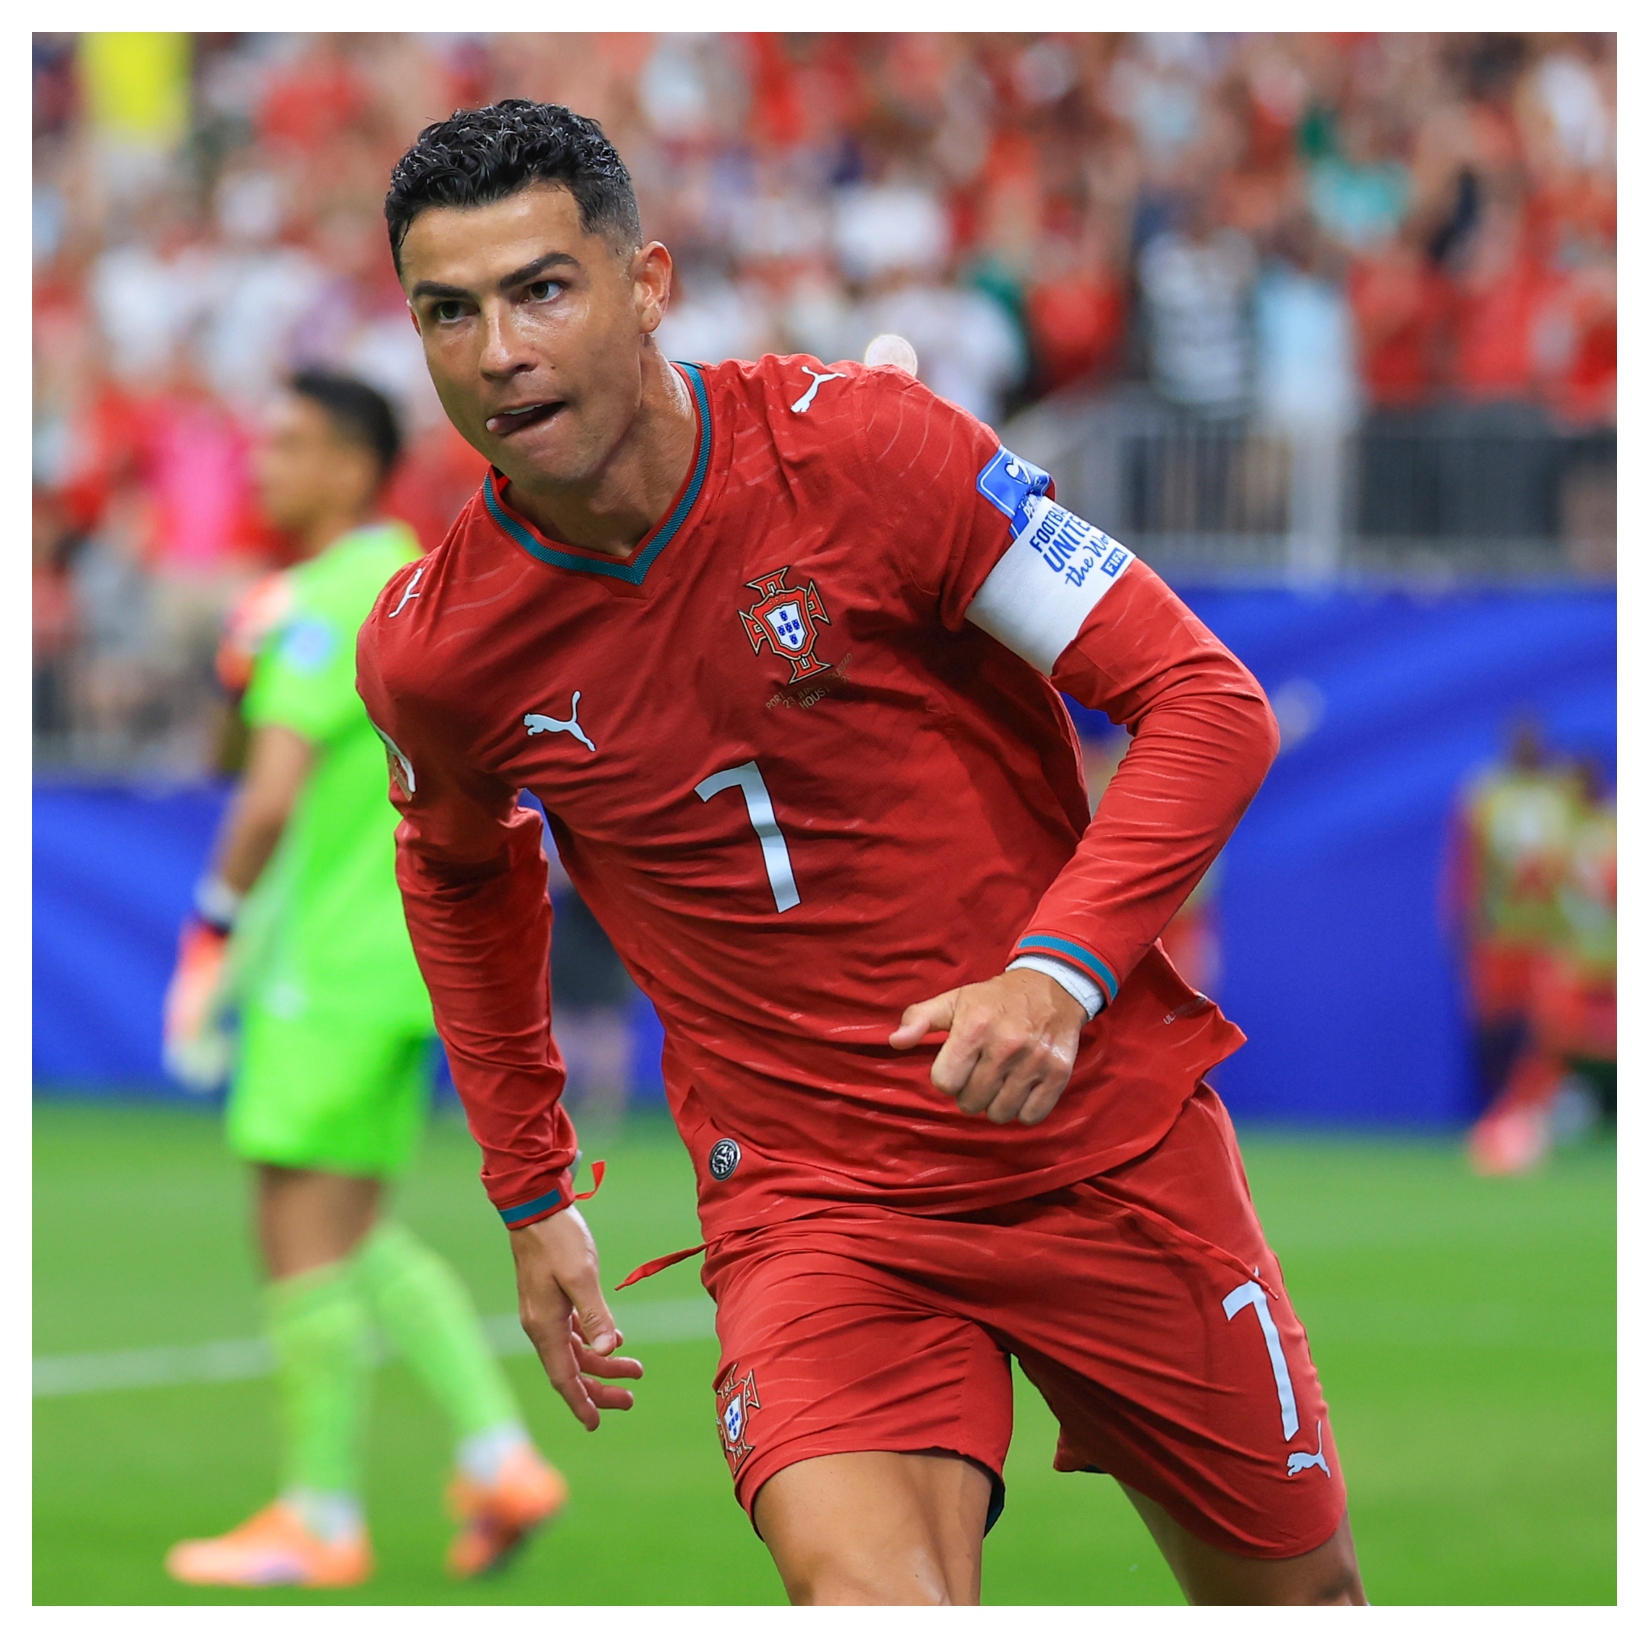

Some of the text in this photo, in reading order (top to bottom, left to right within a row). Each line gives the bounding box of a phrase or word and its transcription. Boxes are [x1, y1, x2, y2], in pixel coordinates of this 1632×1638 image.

[1029, 506, 1069, 553] FOOTBA
[1043, 515, 1091, 573] UNITE
[1065, 556, 1094, 587] the
[1104, 551, 1125, 573] FIFA
[694, 760, 801, 914] 7
[1222, 1266, 1300, 1442] 7
